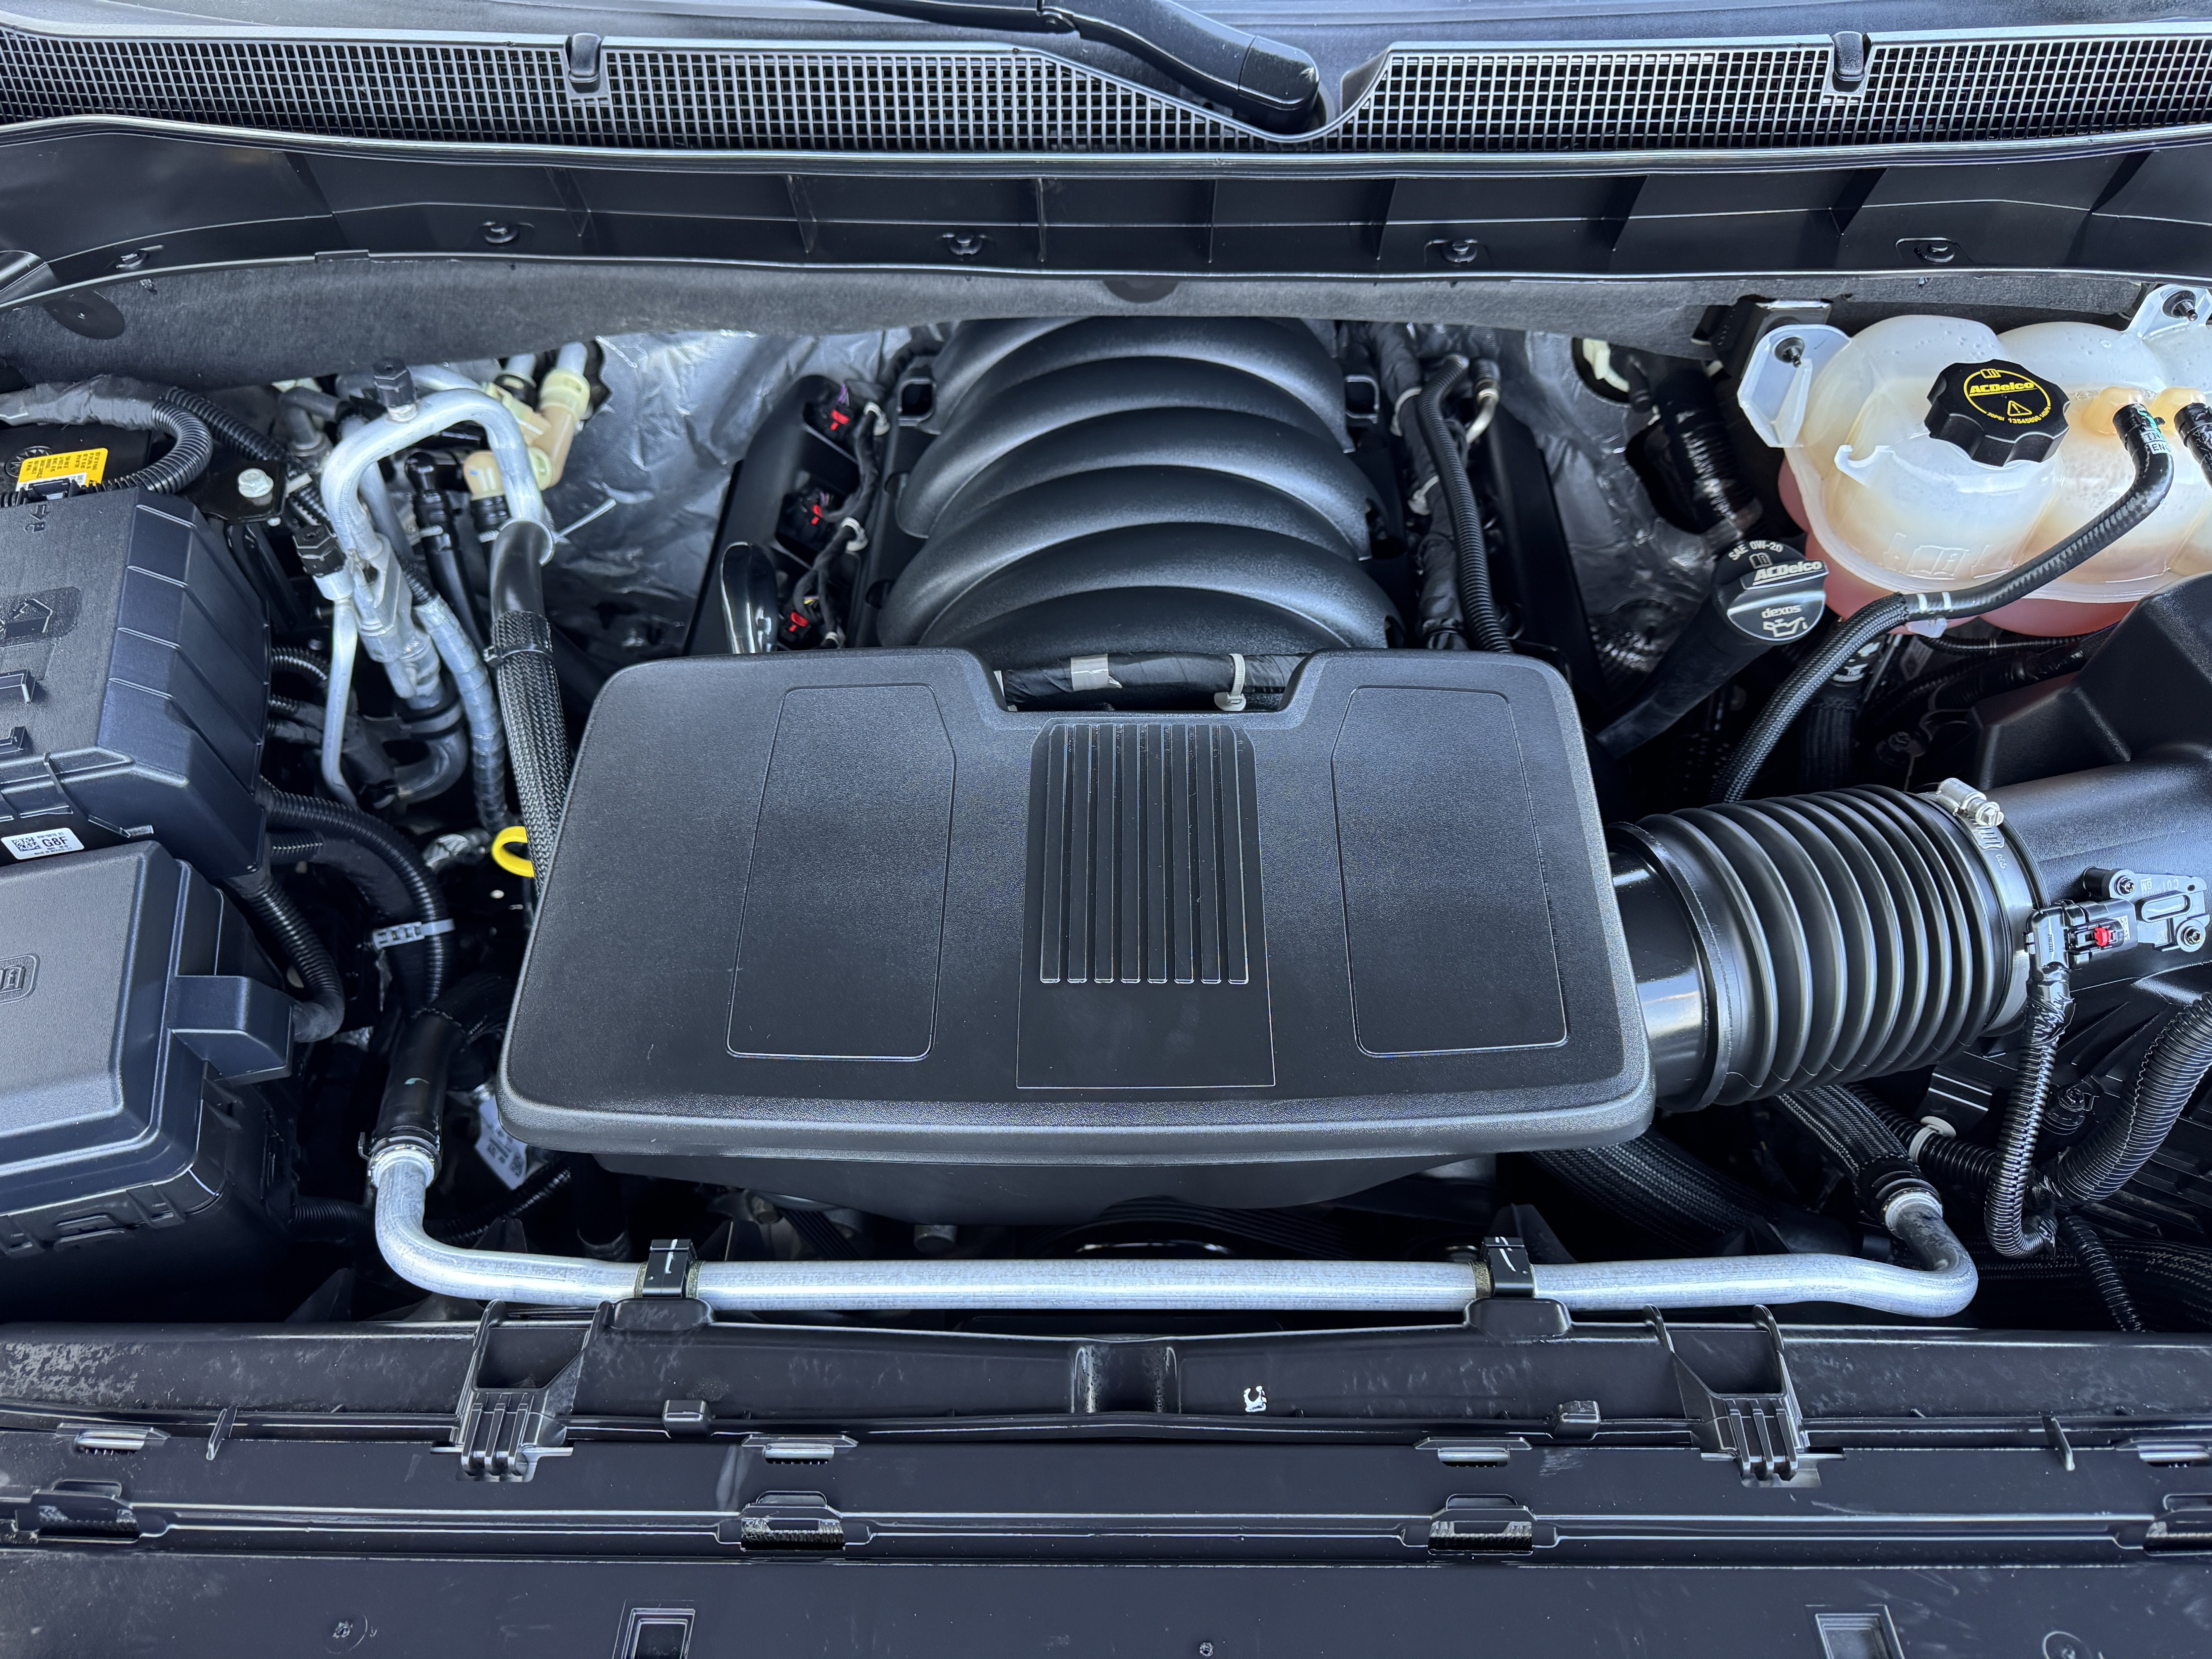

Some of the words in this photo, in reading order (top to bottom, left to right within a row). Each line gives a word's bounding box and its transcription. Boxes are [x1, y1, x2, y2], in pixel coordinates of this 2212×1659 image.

[1970, 382, 2035, 394] ACDelco
[1728, 544, 1749, 560] SAE
[1749, 540, 1783, 553] 0W-20
[1754, 561, 1822, 581] ACDelco
[1761, 605, 1802, 618] dexos
[42, 836, 68, 847] G8F
[2140, 880, 2152, 891] GM
